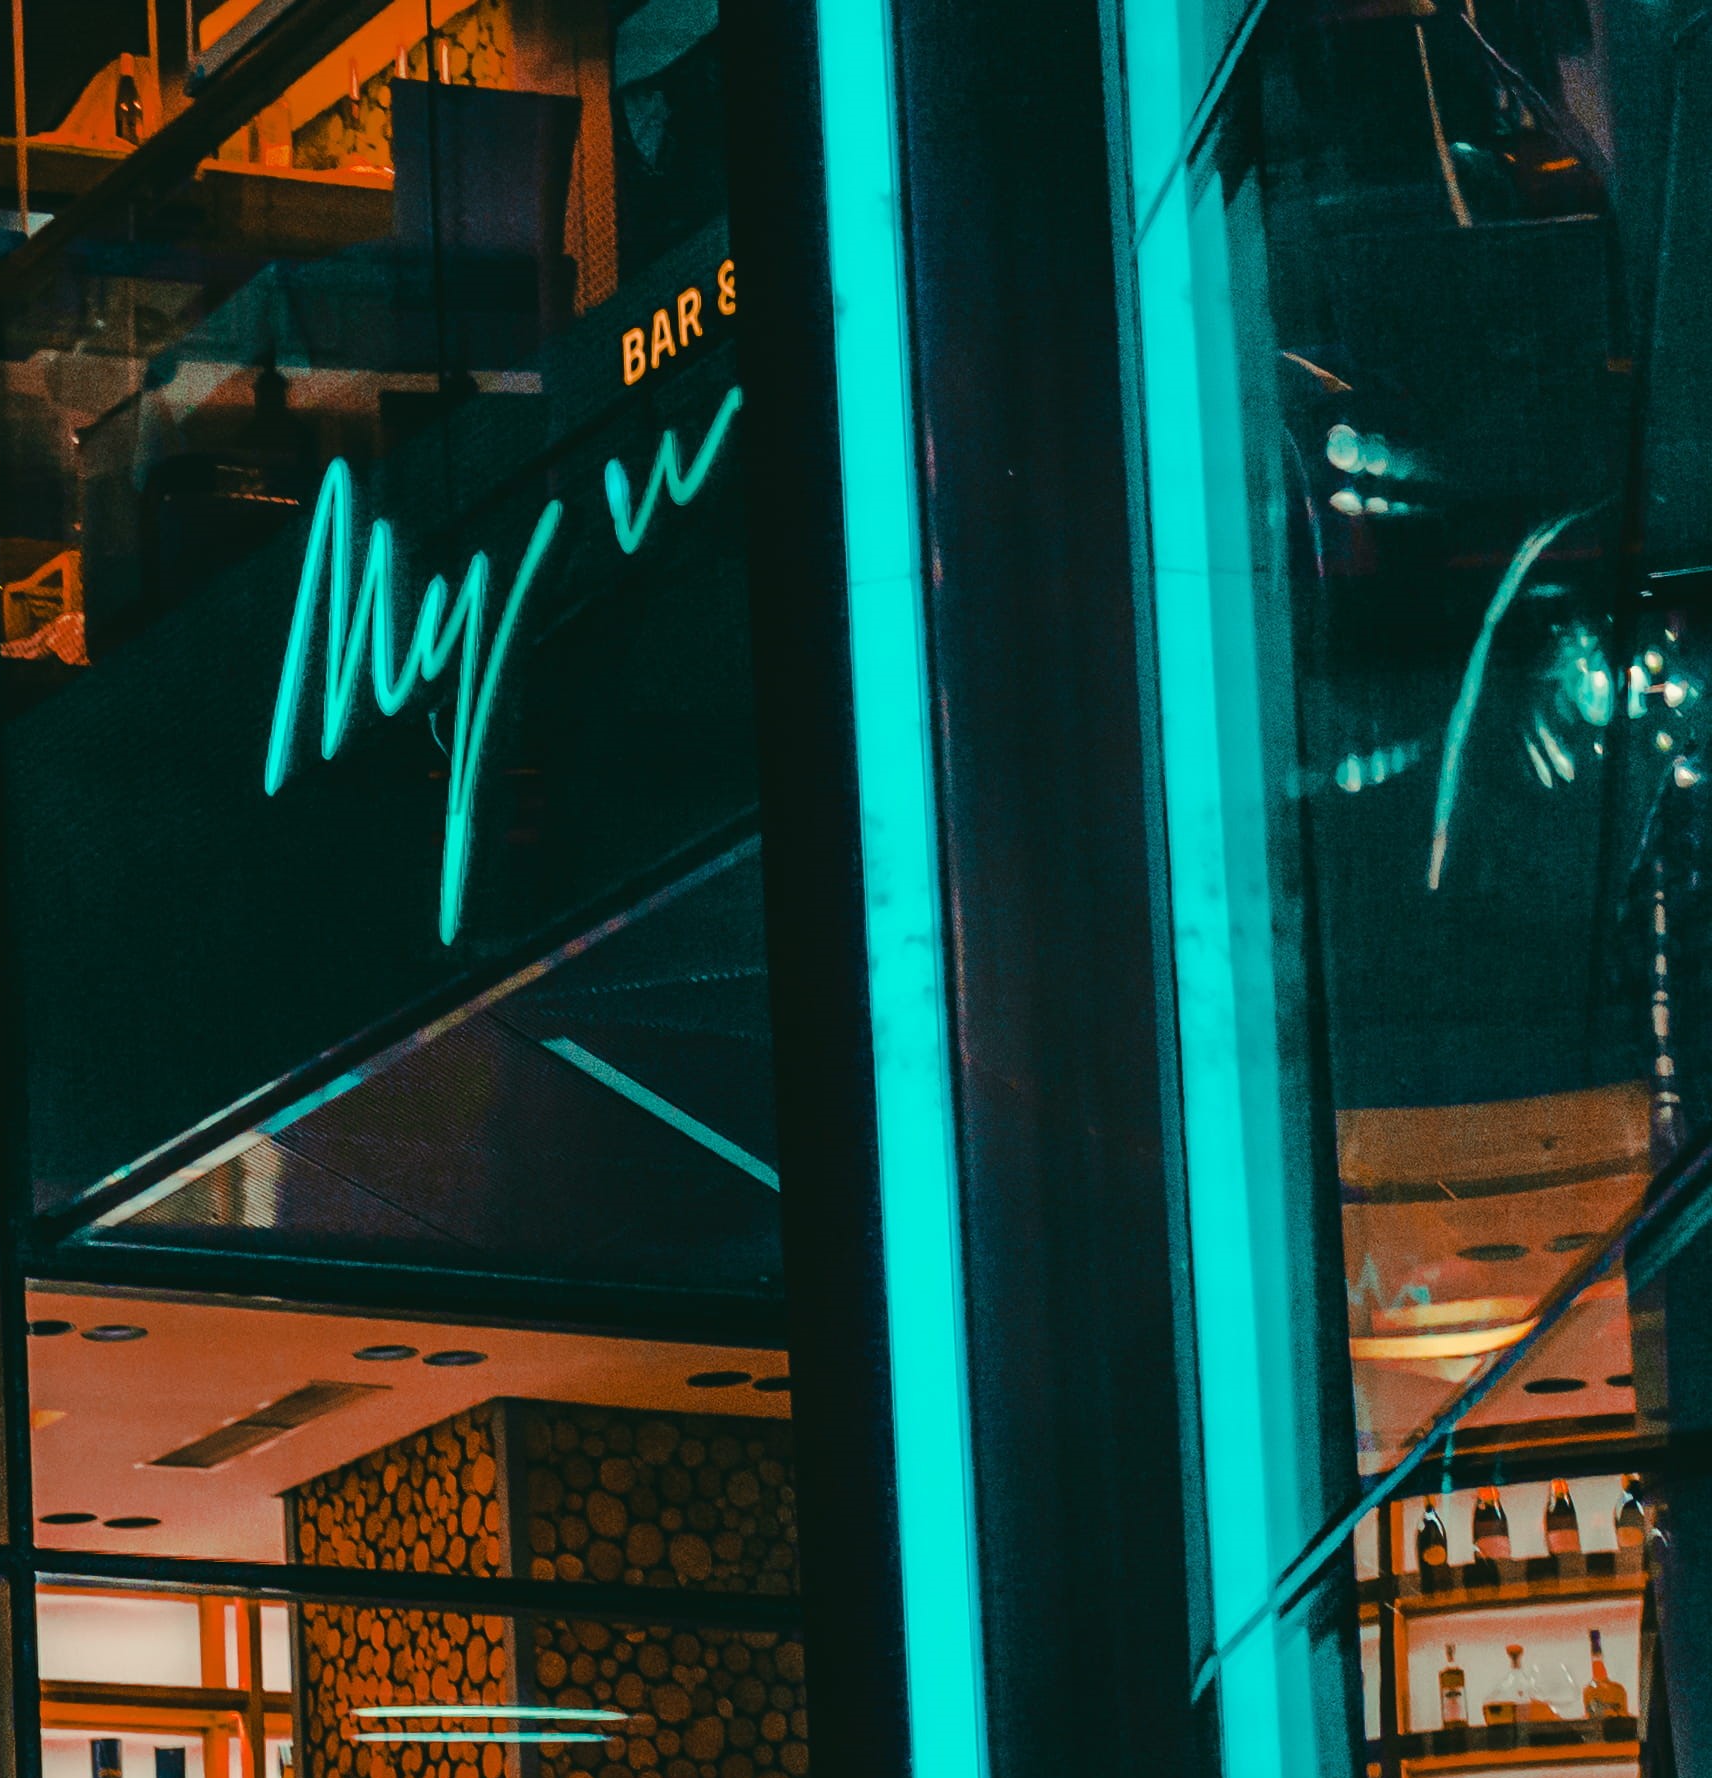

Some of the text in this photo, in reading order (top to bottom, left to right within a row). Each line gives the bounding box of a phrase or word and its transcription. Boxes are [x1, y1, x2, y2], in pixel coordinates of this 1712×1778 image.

[622, 259, 736, 386] BAR &
[265, 457, 562, 946] My
